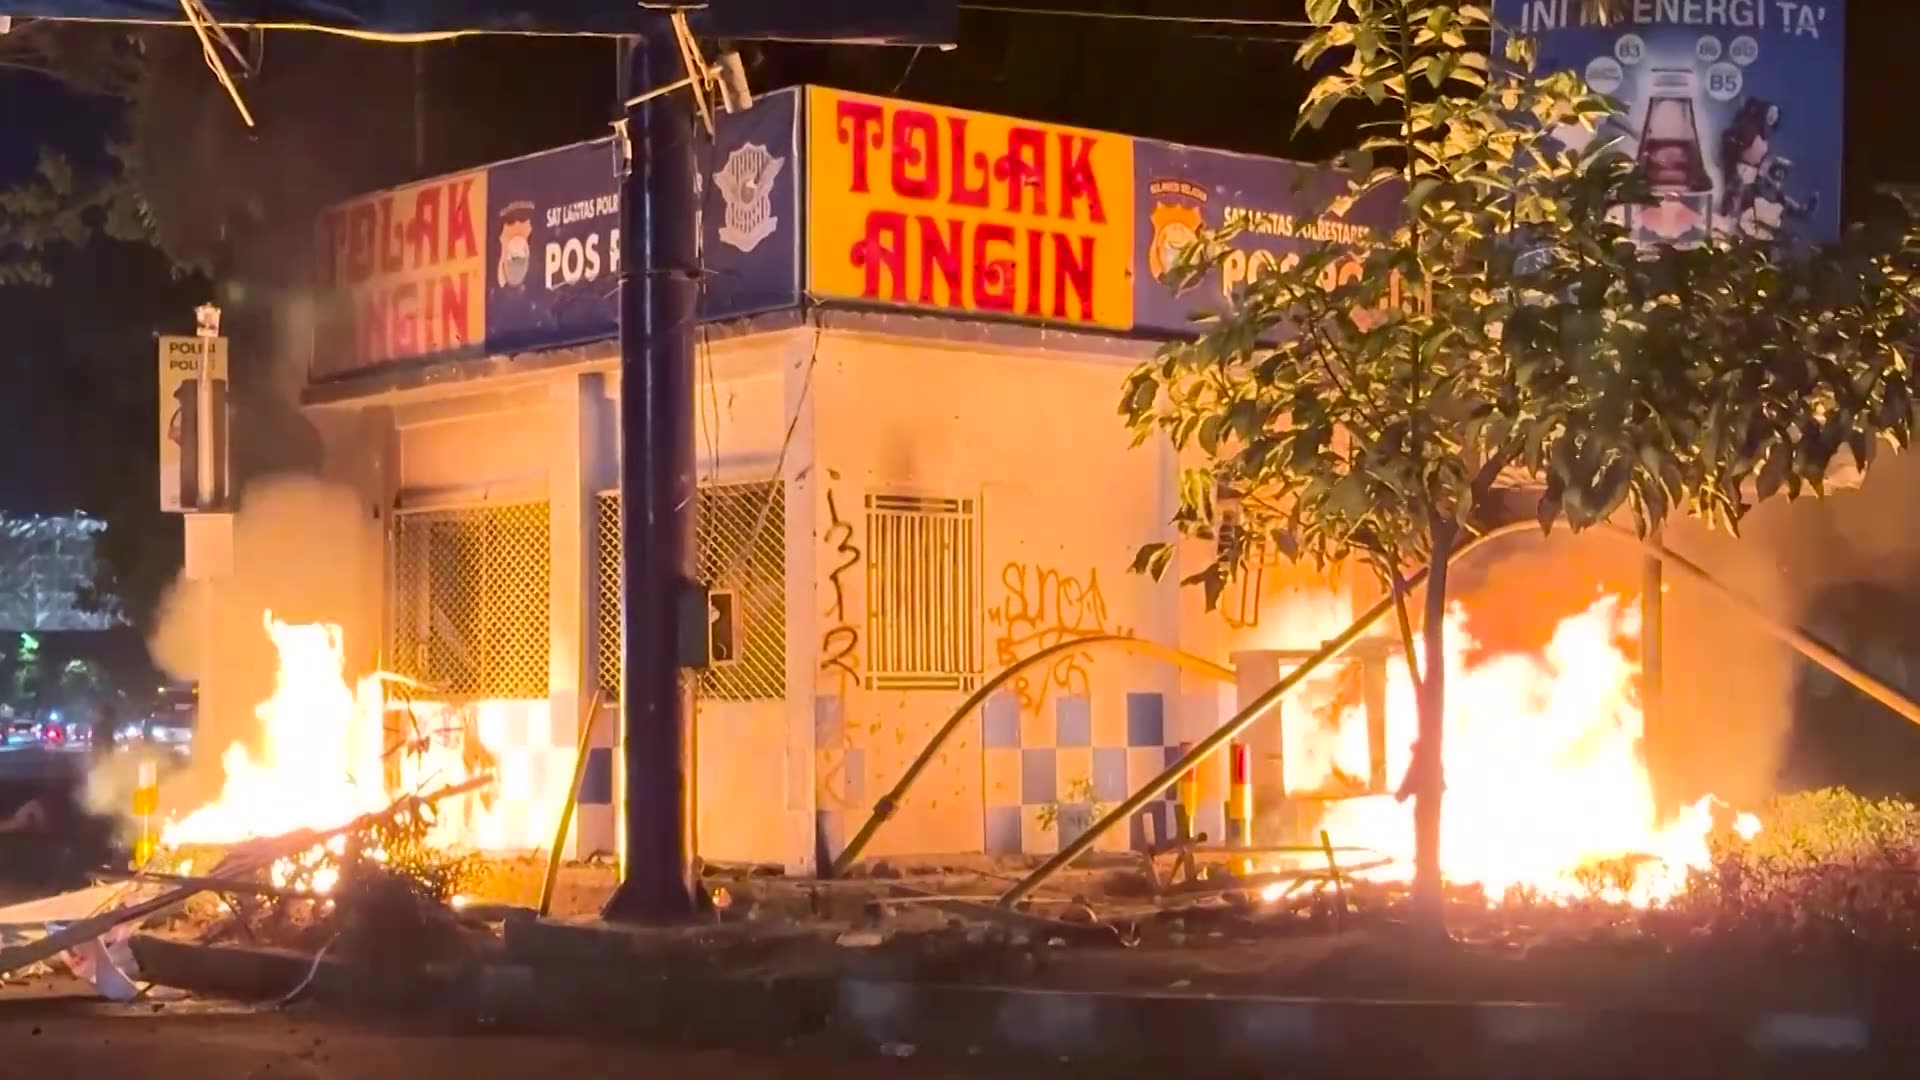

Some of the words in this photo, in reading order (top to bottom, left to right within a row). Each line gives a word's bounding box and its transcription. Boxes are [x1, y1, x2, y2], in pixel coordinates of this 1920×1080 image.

[1521, 0, 1568, 33] INI
[1633, 0, 1765, 28] ENERGI
[1777, 2, 1826, 39] TA'
[1709, 74, 1737, 92] B5
[837, 100, 1107, 224] TOLAK
[320, 177, 479, 287] TOLAK
[546, 207, 562, 228] SAT
[563, 199, 595, 224] LANTAS
[545, 233, 600, 290] POS
[851, 210, 1096, 322] ANGIN
[342, 272, 469, 364] NGIN
[169, 359, 216, 372] POLII
